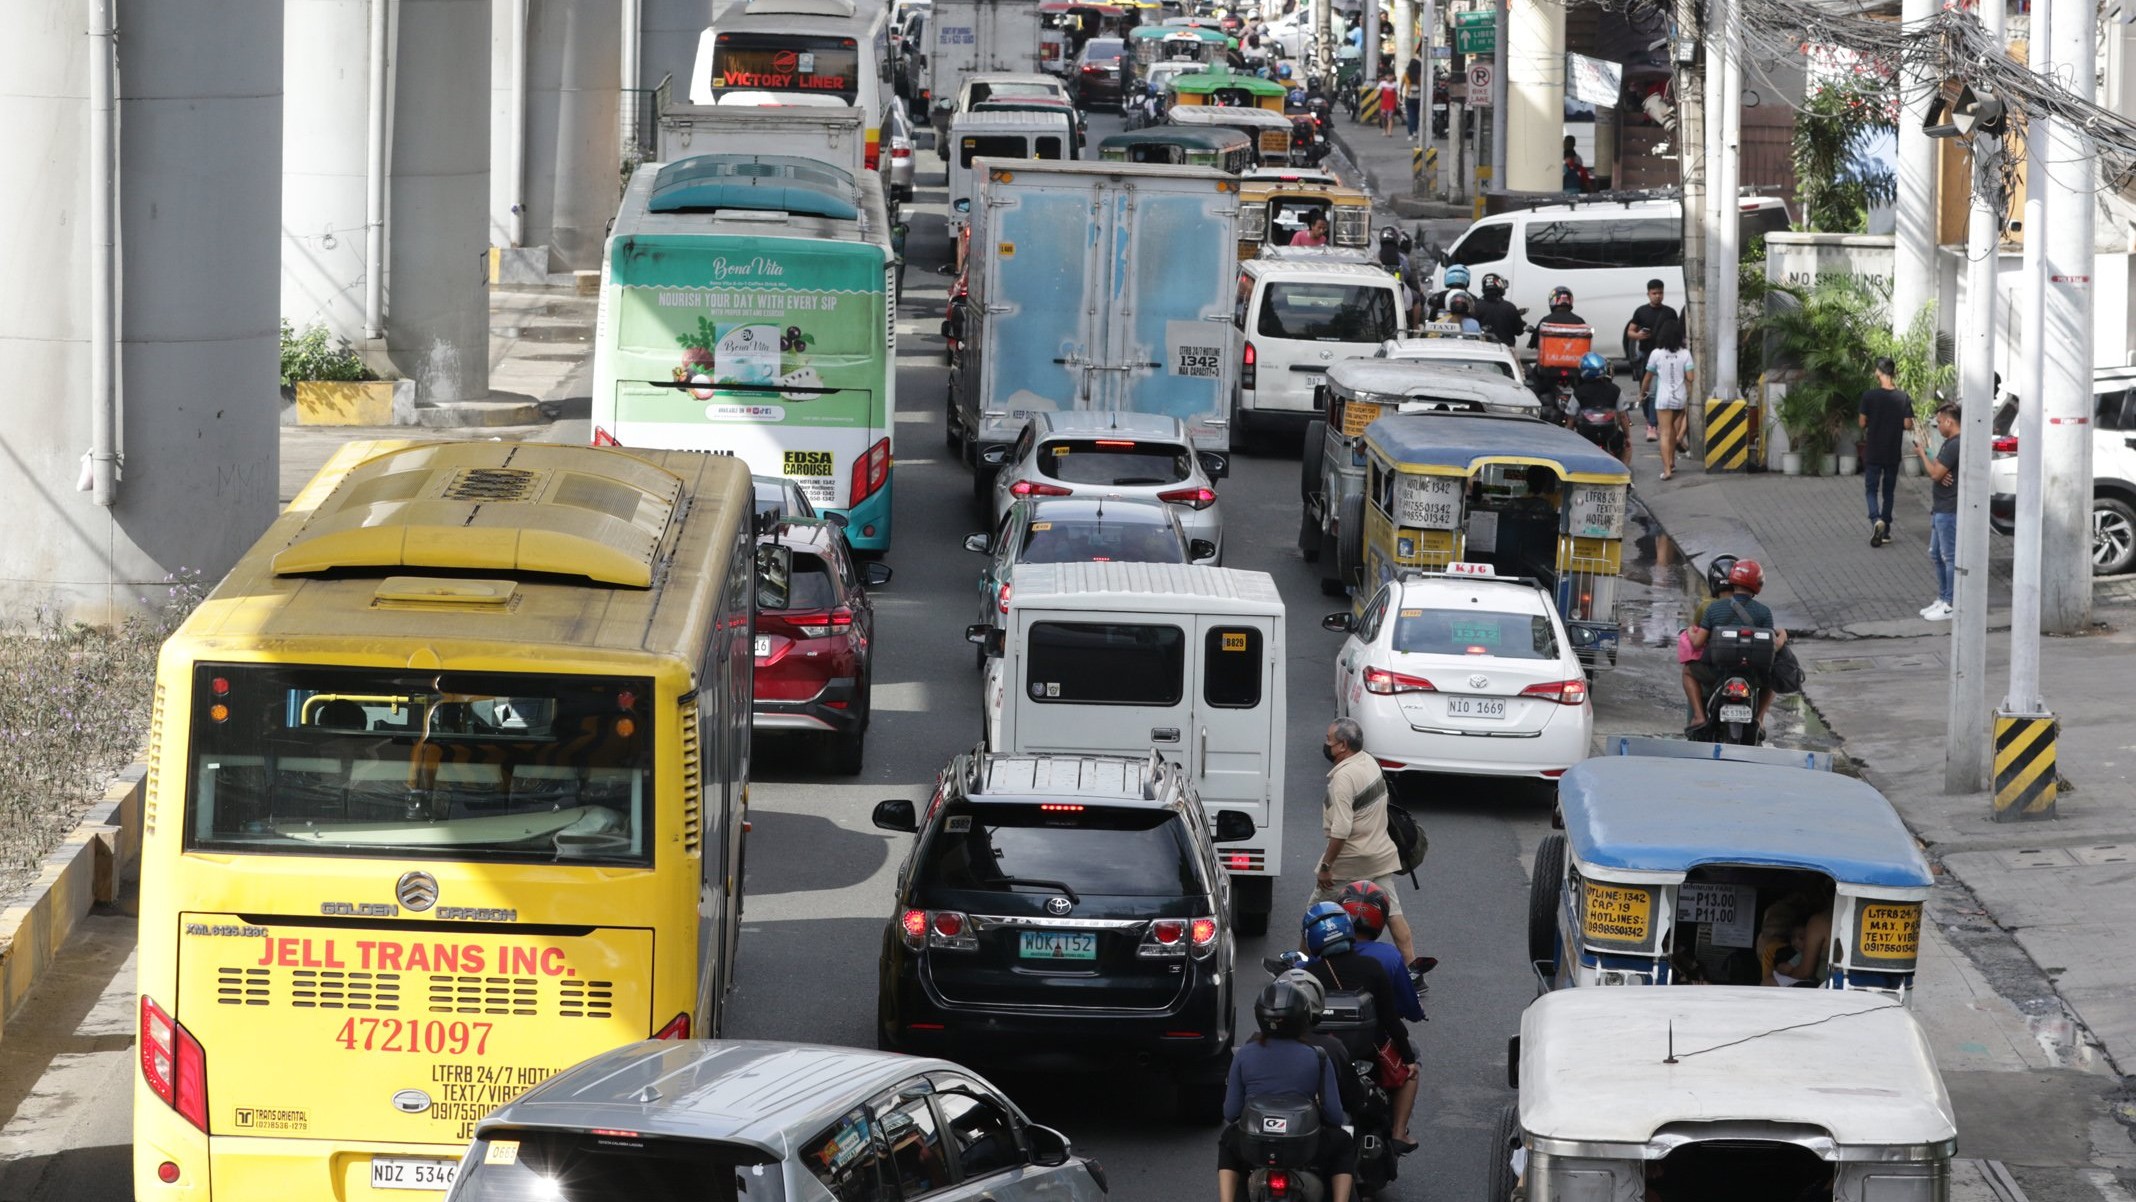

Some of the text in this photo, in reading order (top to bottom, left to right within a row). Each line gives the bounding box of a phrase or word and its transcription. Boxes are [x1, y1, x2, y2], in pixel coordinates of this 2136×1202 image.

[1473, 30, 1495, 38] LIBER
[723, 69, 793, 87] VICTORY
[799, 75, 844, 89] LINER
[1472, 88, 1488, 96] BIKE
[1471, 96, 1489, 104] LANE
[712, 256, 784, 280] Bona Vita
[1789, 271, 1810, 286] NO
[658, 292, 838, 312] NOURISH YOUR DAY WITH EVERY SIP
[1179, 345, 1191, 356] LTFRB
[1203, 346, 1221, 357] HOTLINE
[1181, 355, 1218, 368] 1342
[1545, 353, 1580, 363] LALAMO
[1012, 410, 1025, 420] KEEP
[784, 451, 833, 464] EDSA
[783, 464, 833, 477] CAROUSEL
[1406, 479, 1451, 495] HOTLINE 1342
[1585, 491, 1607, 504] LTFRB
[1454, 628, 1498, 639] 1342
[1476, 702, 1504, 715] 1669
[1682, 883, 1733, 893] MINIMUM FARE
[1586, 886, 1647, 904] OTLINE: 1342
[1696, 892, 1735, 908] P13.00
[320, 901, 518, 922] GOLDEN DRAGON
[1591, 898, 1631, 913] CAP. 19
[1590, 910, 1644, 925] HOTLINES:
[1695, 908, 1734, 923] P11.00
[1868, 908, 1899, 919] LTFRB
[1870, 921, 1899, 932] MAX.
[1025, 934, 1054, 951] WOK
[1865, 932, 1895, 942] TEXT/
[258, 937, 576, 977] JELL TRANS INC.
[335, 1016, 494, 1057] 4721097
[432, 1064, 473, 1084] LTFRB
[476, 1065, 514, 1085] 24/7
[255, 1109, 308, 1122] TRANS ORIENTAL
[255, 1121, 308, 1130] (02)8536-1279
[374, 1165, 456, 1184] NDZ 5346
